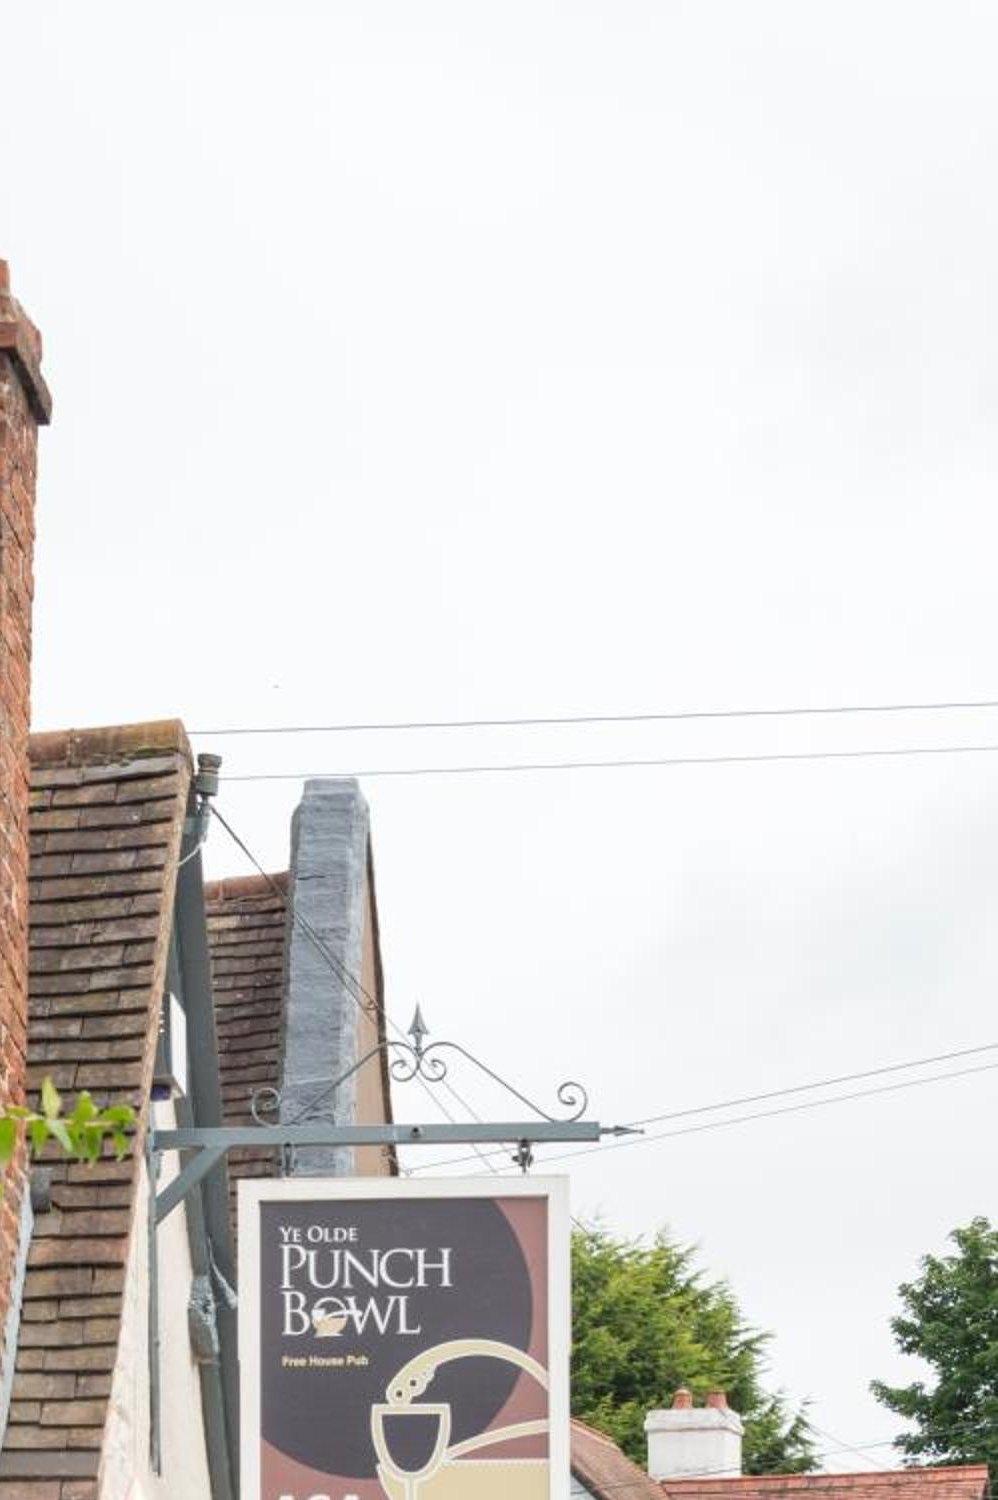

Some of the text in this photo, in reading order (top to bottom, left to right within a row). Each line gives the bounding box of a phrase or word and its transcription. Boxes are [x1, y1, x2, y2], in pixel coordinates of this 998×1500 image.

[280, 1225, 359, 1242] YE OLDE
[279, 1243, 454, 1289] PUNCH
[281, 1290, 422, 1337] BOWL
[281, 1354, 369, 1367] Free House Pub
